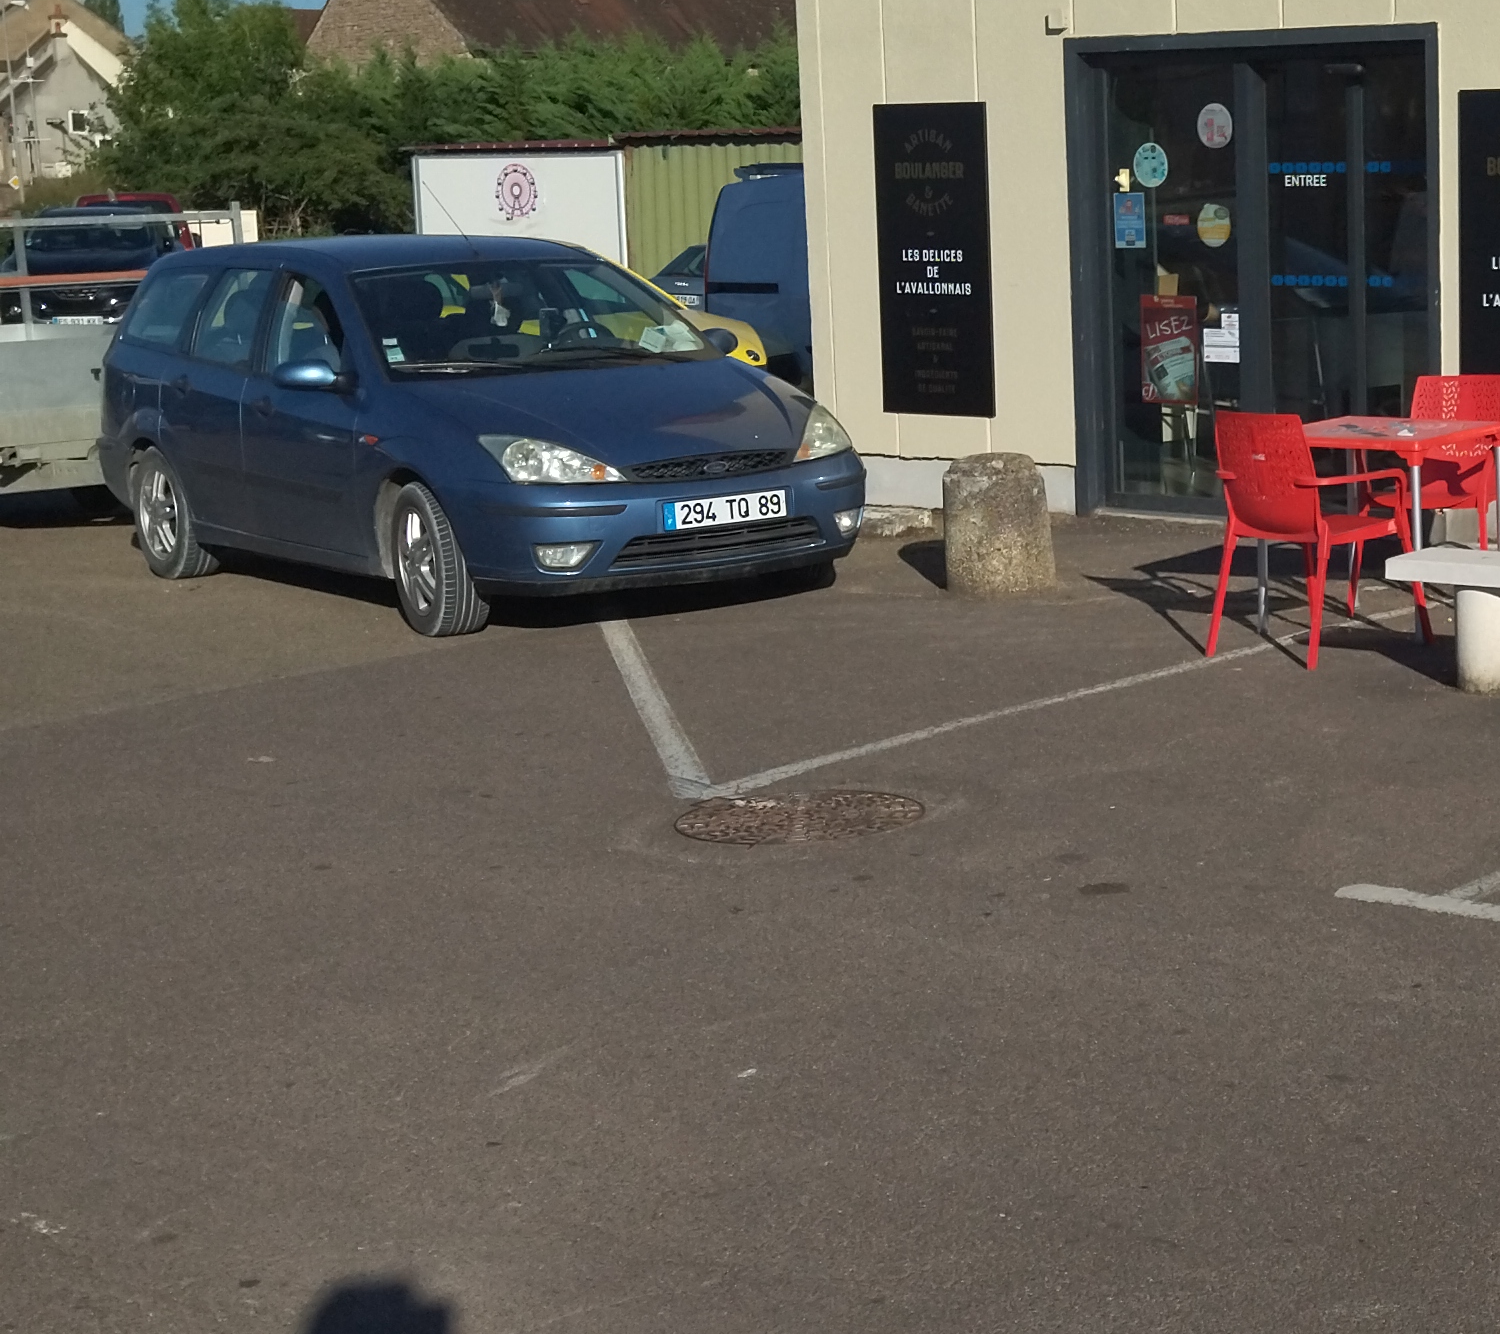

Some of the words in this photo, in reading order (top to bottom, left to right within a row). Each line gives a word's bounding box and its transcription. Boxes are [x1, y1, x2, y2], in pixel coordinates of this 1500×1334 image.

[904, 129, 953, 153] ARTISAN
[894, 162, 964, 179] BOULANGER
[1285, 175, 1327, 187] ENTREE
[906, 193, 954, 216] BANETTE
[902, 249, 919, 261] LES
[923, 249, 963, 262] DELICES
[927, 266, 939, 278] DE
[896, 282, 972, 295] L'AVALLONNAIS
[1146, 316, 1192, 339] LISEZ
[680, 501, 717, 525] 294
[725, 497, 750, 519] TQ
[758, 494, 781, 516] 89
